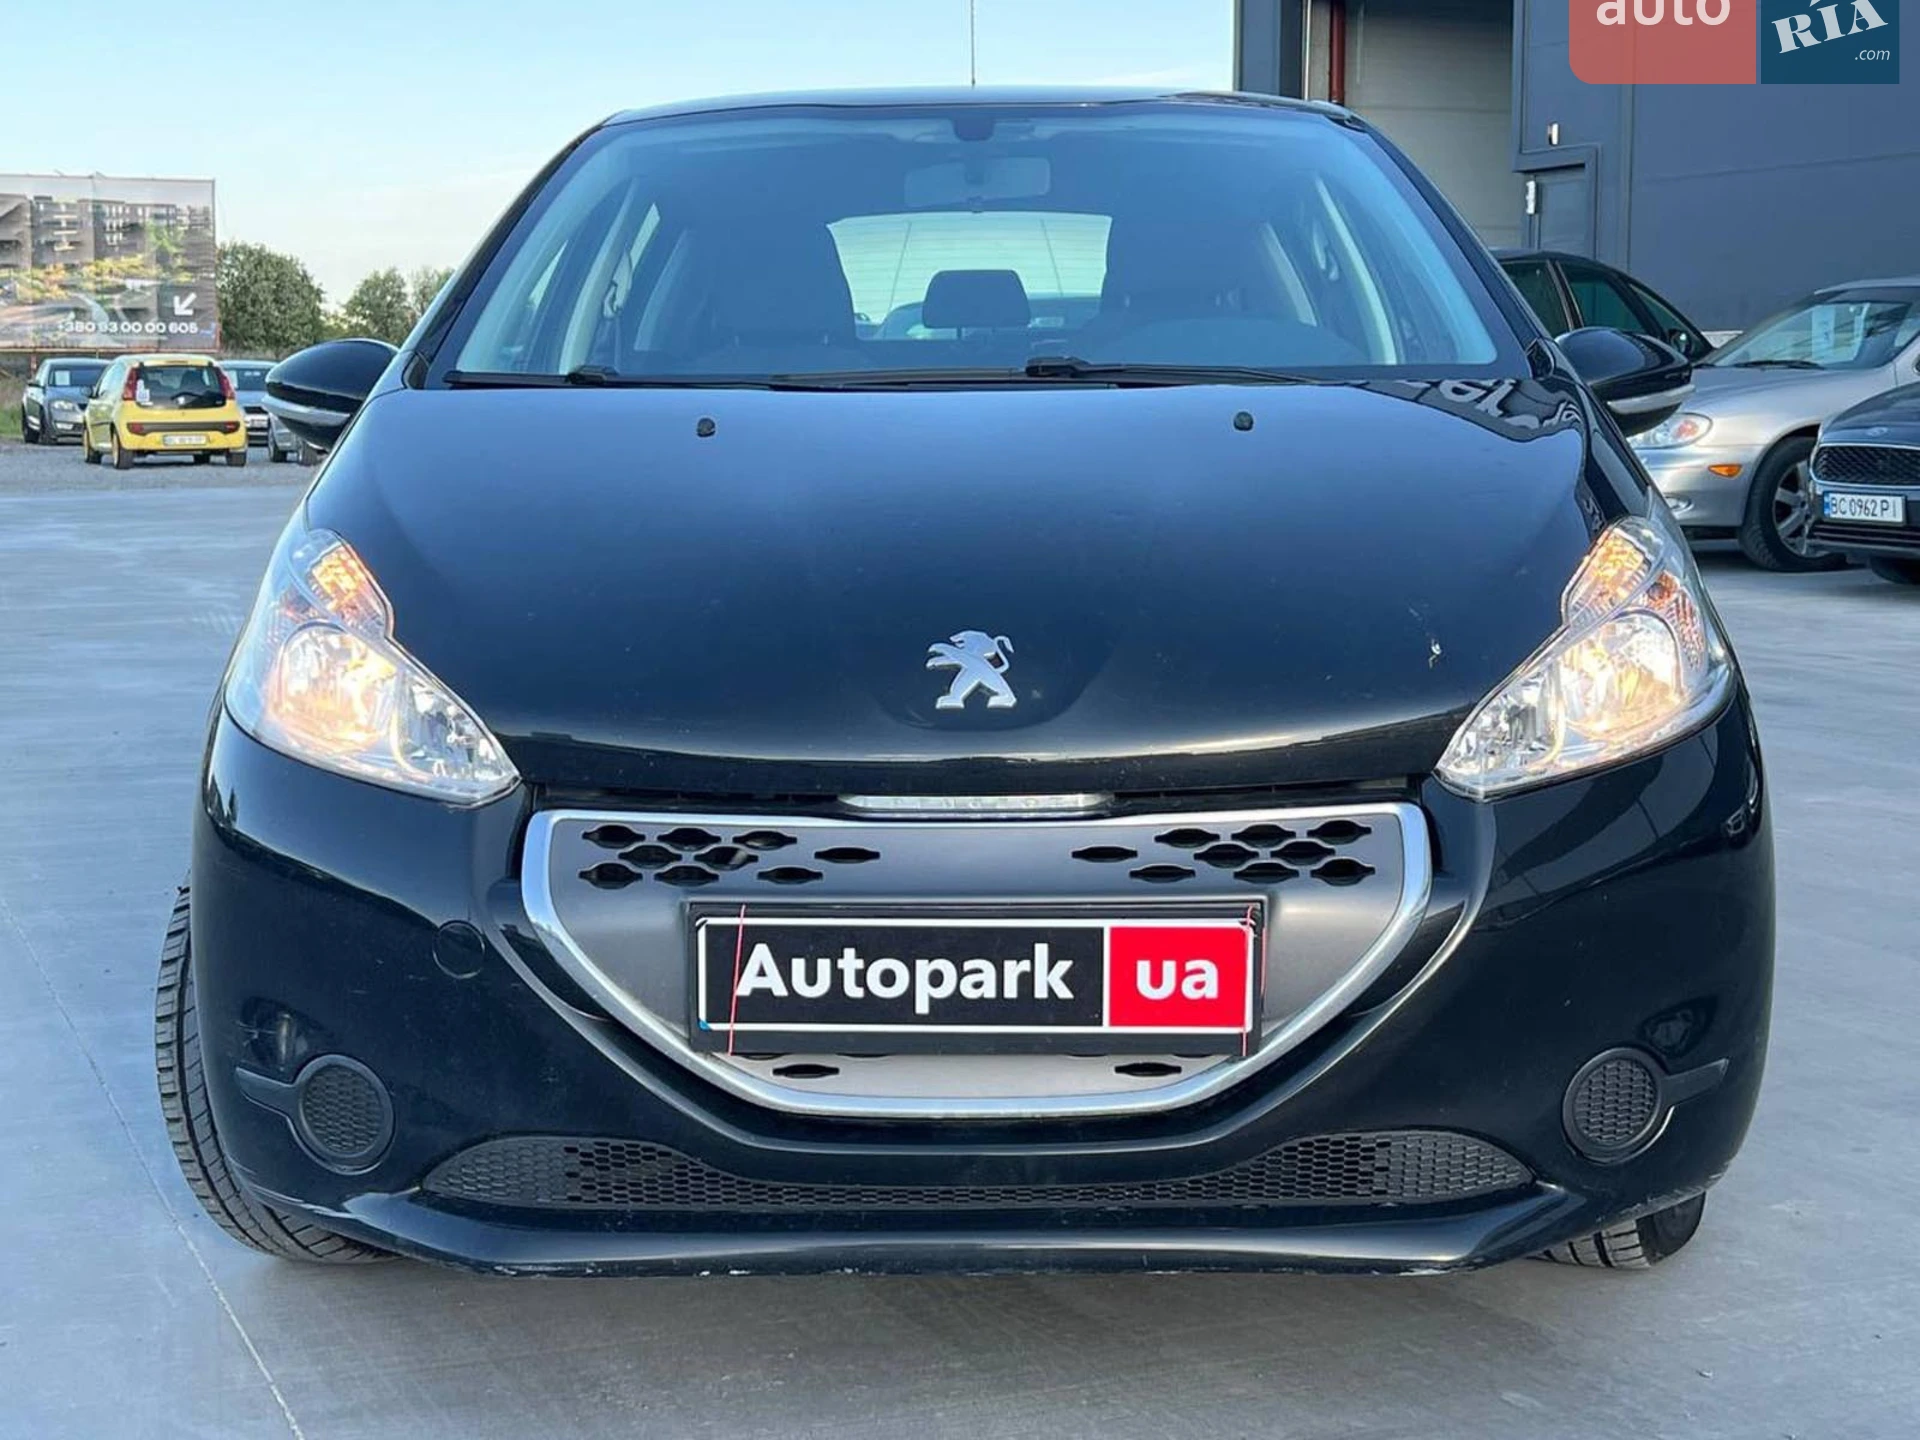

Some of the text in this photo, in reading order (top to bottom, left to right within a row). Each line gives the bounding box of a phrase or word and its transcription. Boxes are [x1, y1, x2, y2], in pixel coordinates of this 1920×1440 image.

[120, 321, 142, 334] 00
[144, 321, 167, 334] 00
[735, 943, 1219, 1015] Autopark ua
